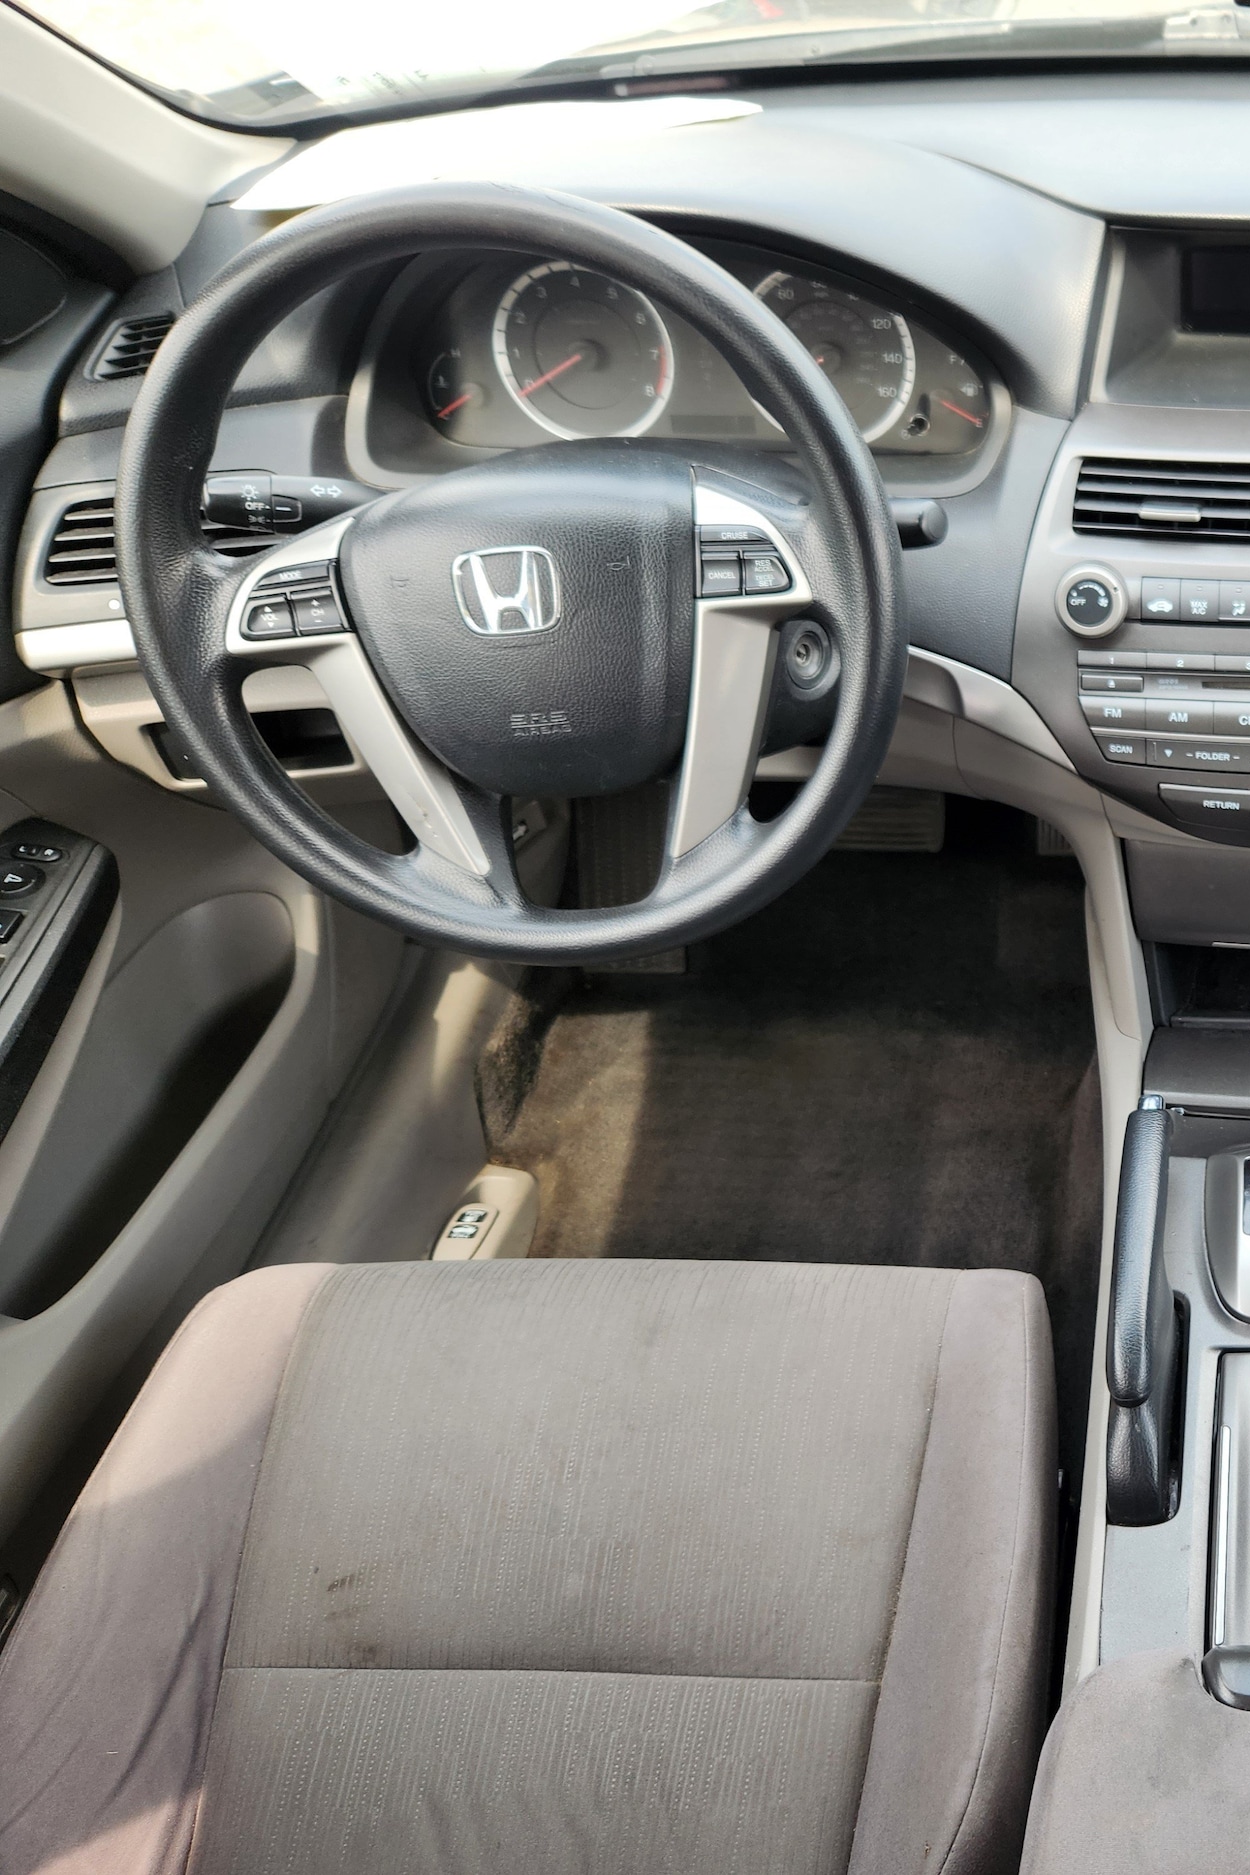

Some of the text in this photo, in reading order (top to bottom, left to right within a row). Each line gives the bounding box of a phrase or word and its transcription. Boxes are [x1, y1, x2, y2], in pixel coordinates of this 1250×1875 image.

[537, 287, 547, 299] 3
[516, 311, 527, 324] 2
[872, 319, 891, 330] 120
[883, 353, 903, 364] 140
[950, 355, 957, 364] F
[644, 385, 655, 397] 8
[878, 386, 897, 398] 160
[244, 501, 265, 511] OFF
[721, 531, 748, 539] CRUISE
[279, 570, 302, 580] MODE
[708, 571, 736, 580] CANCEL
[1190, 600, 1208, 609] MAX
[1192, 607, 1206, 616] A/C
[261, 613, 279, 621] VOL
[1177, 659, 1184, 668] 2
[1104, 708, 1122, 718] FM
[1169, 712, 1188, 723] AM
[1109, 744, 1133, 754] SCAN
[1195, 751, 1230, 762] FOLDER
[1203, 799, 1240, 810] RETURN
